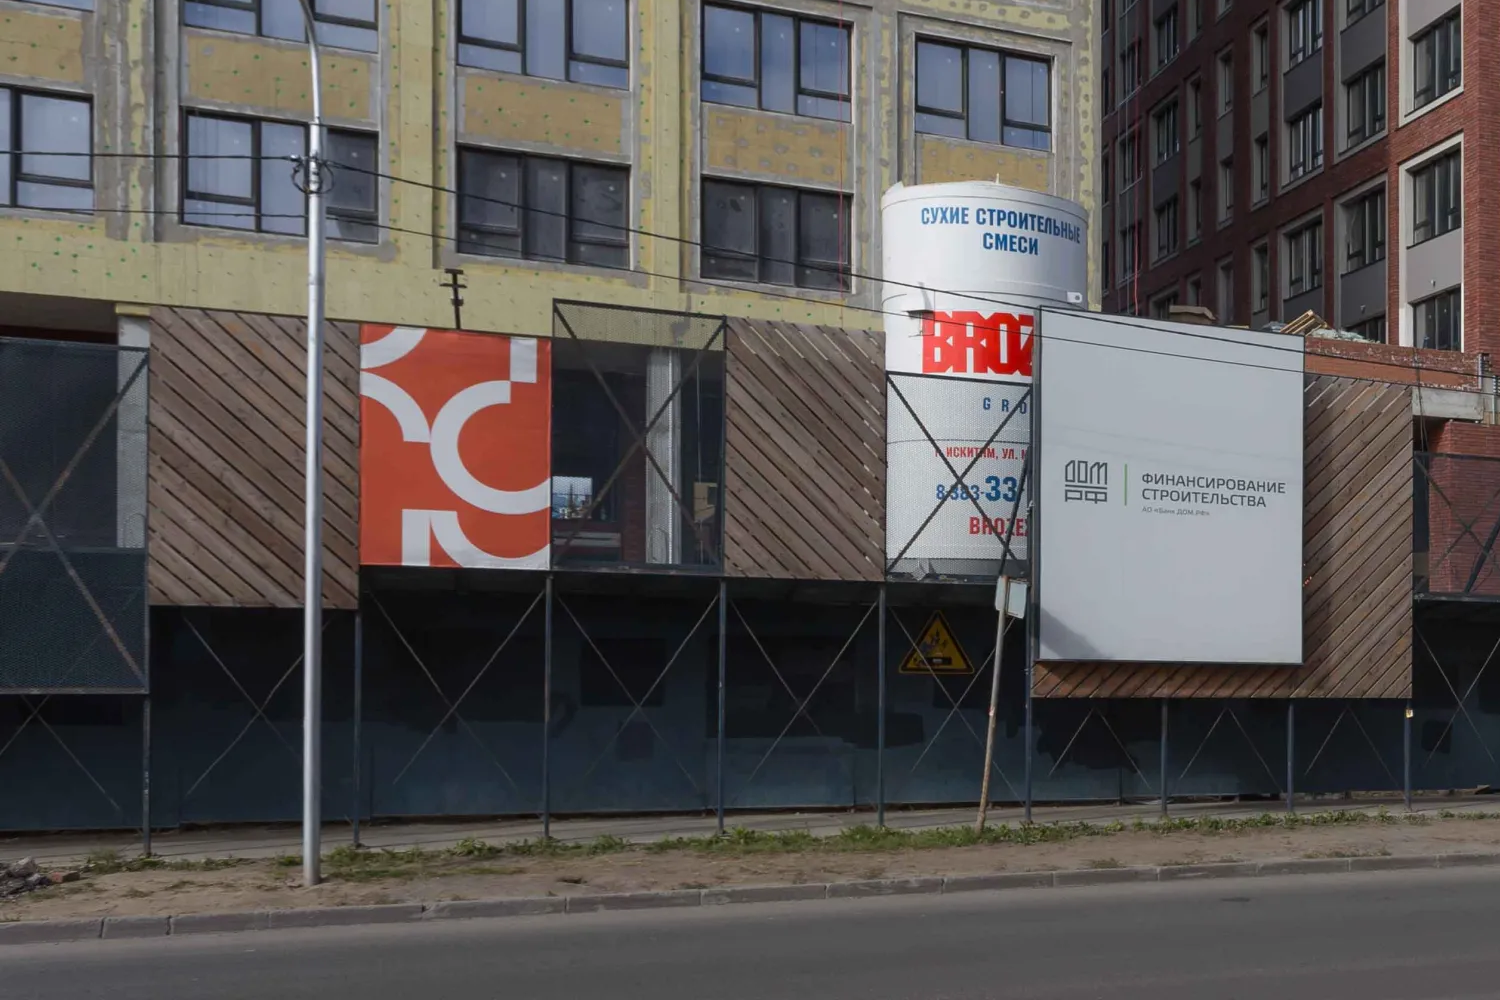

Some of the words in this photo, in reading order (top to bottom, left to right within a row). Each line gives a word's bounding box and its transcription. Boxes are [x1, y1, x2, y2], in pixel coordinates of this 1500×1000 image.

[921, 207, 969, 225] СУХИЕ
[976, 207, 1081, 244] СТРОИТЕЛЬНЫЕ
[982, 232, 1039, 256] СМЕСИ
[1065, 460, 1108, 485] ДОМ
[1142, 472, 1286, 494] ФИНАНСИРОВАНИЕ
[1142, 488, 1267, 508] СТРОИТЕЛЬСТВА
[968, 516, 1029, 537] BROE
